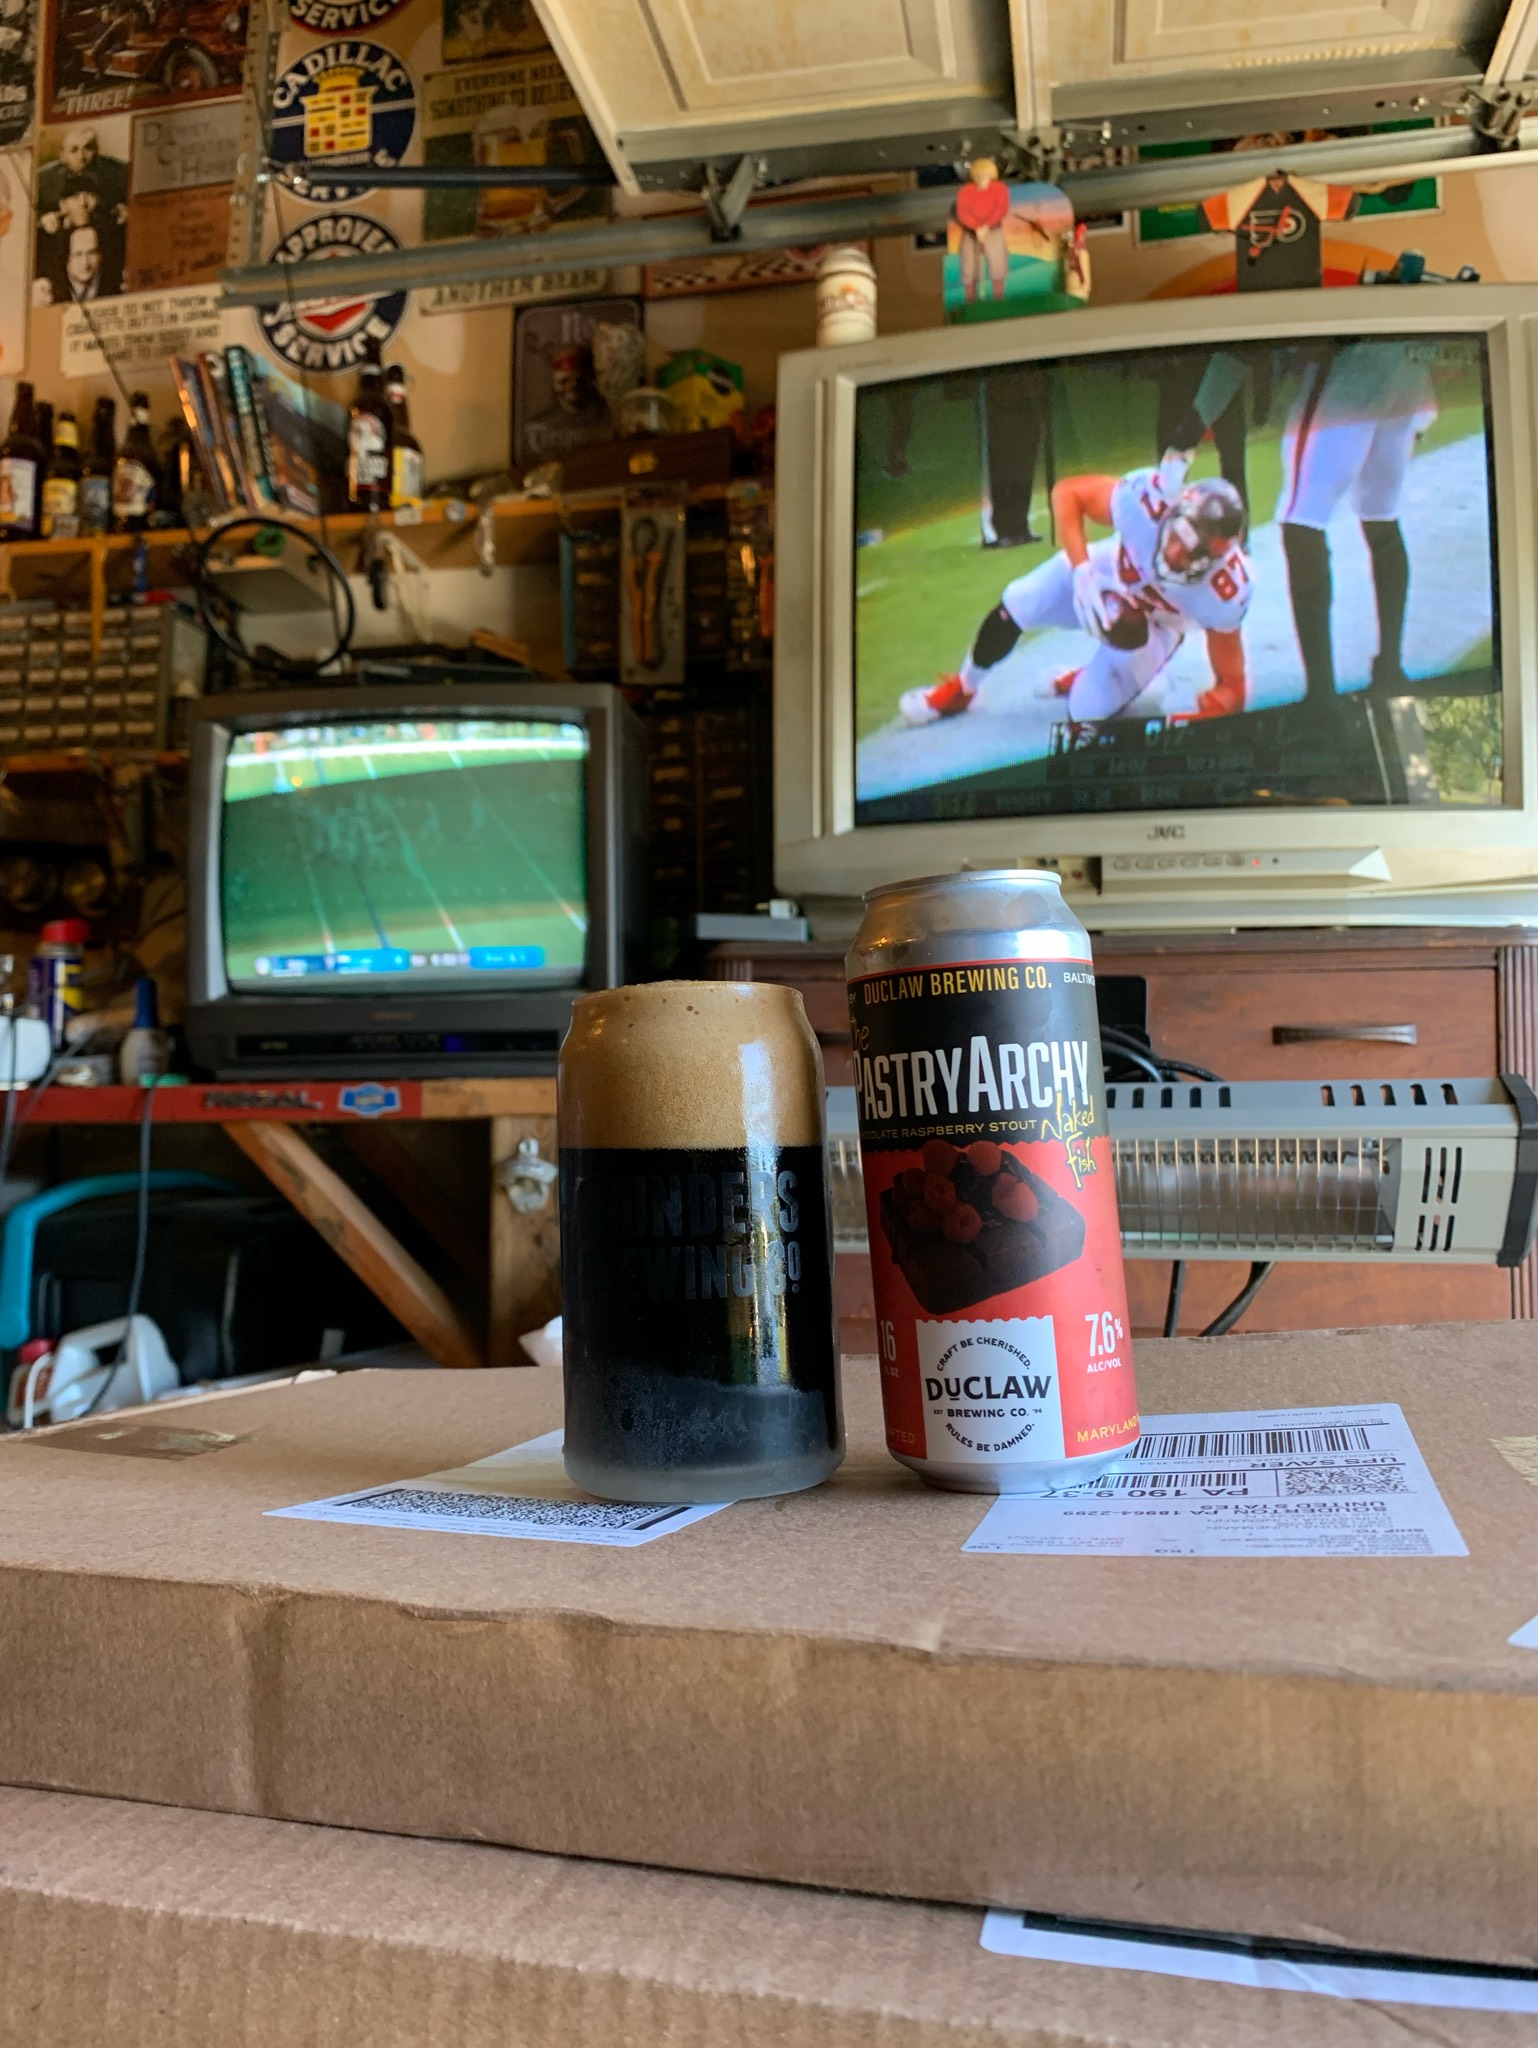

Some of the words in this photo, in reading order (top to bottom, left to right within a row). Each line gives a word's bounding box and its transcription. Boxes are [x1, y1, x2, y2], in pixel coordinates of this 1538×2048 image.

[272, 43, 408, 110] CADILLAC
[272, 314, 391, 368] SERVICE
[1146, 824, 1186, 841] JVC
[864, 975, 923, 1005] DUCLAW
[931, 968, 1019, 996] BREWING
[1025, 966, 1052, 990] CO.
[1041, 1091, 1095, 1140] Naked
[901, 1123, 984, 1138] RASPBERRY
[989, 1119, 1036, 1133] STOUT
[1065, 1130, 1096, 1188] Fish
[880, 1319, 898, 1362] 16
[937, 1344, 958, 1372] CRAFT
[960, 1338, 974, 1348] BE
[976, 1336, 1031, 1370] CHERISHED.
[1087, 1359, 1122, 1374] ALC/VOL
[947, 1408, 1005, 1418] BREWING
[1010, 1407, 1030, 1417] CO.
[945, 1422, 973, 1448] RULES
[976, 1442, 990, 1452] BE
[994, 1423, 1035, 1452] DAMNED.
[1077, 1415, 1137, 1442] MARYLAND
[1250, 1458, 1336, 1469] SAVER
[1344, 1456, 1397, 1466] UPS
[1040, 1488, 1114, 1499] 9-37
[1127, 1489, 1188, 1498] 190
[1202, 1488, 1249, 1497] PA
